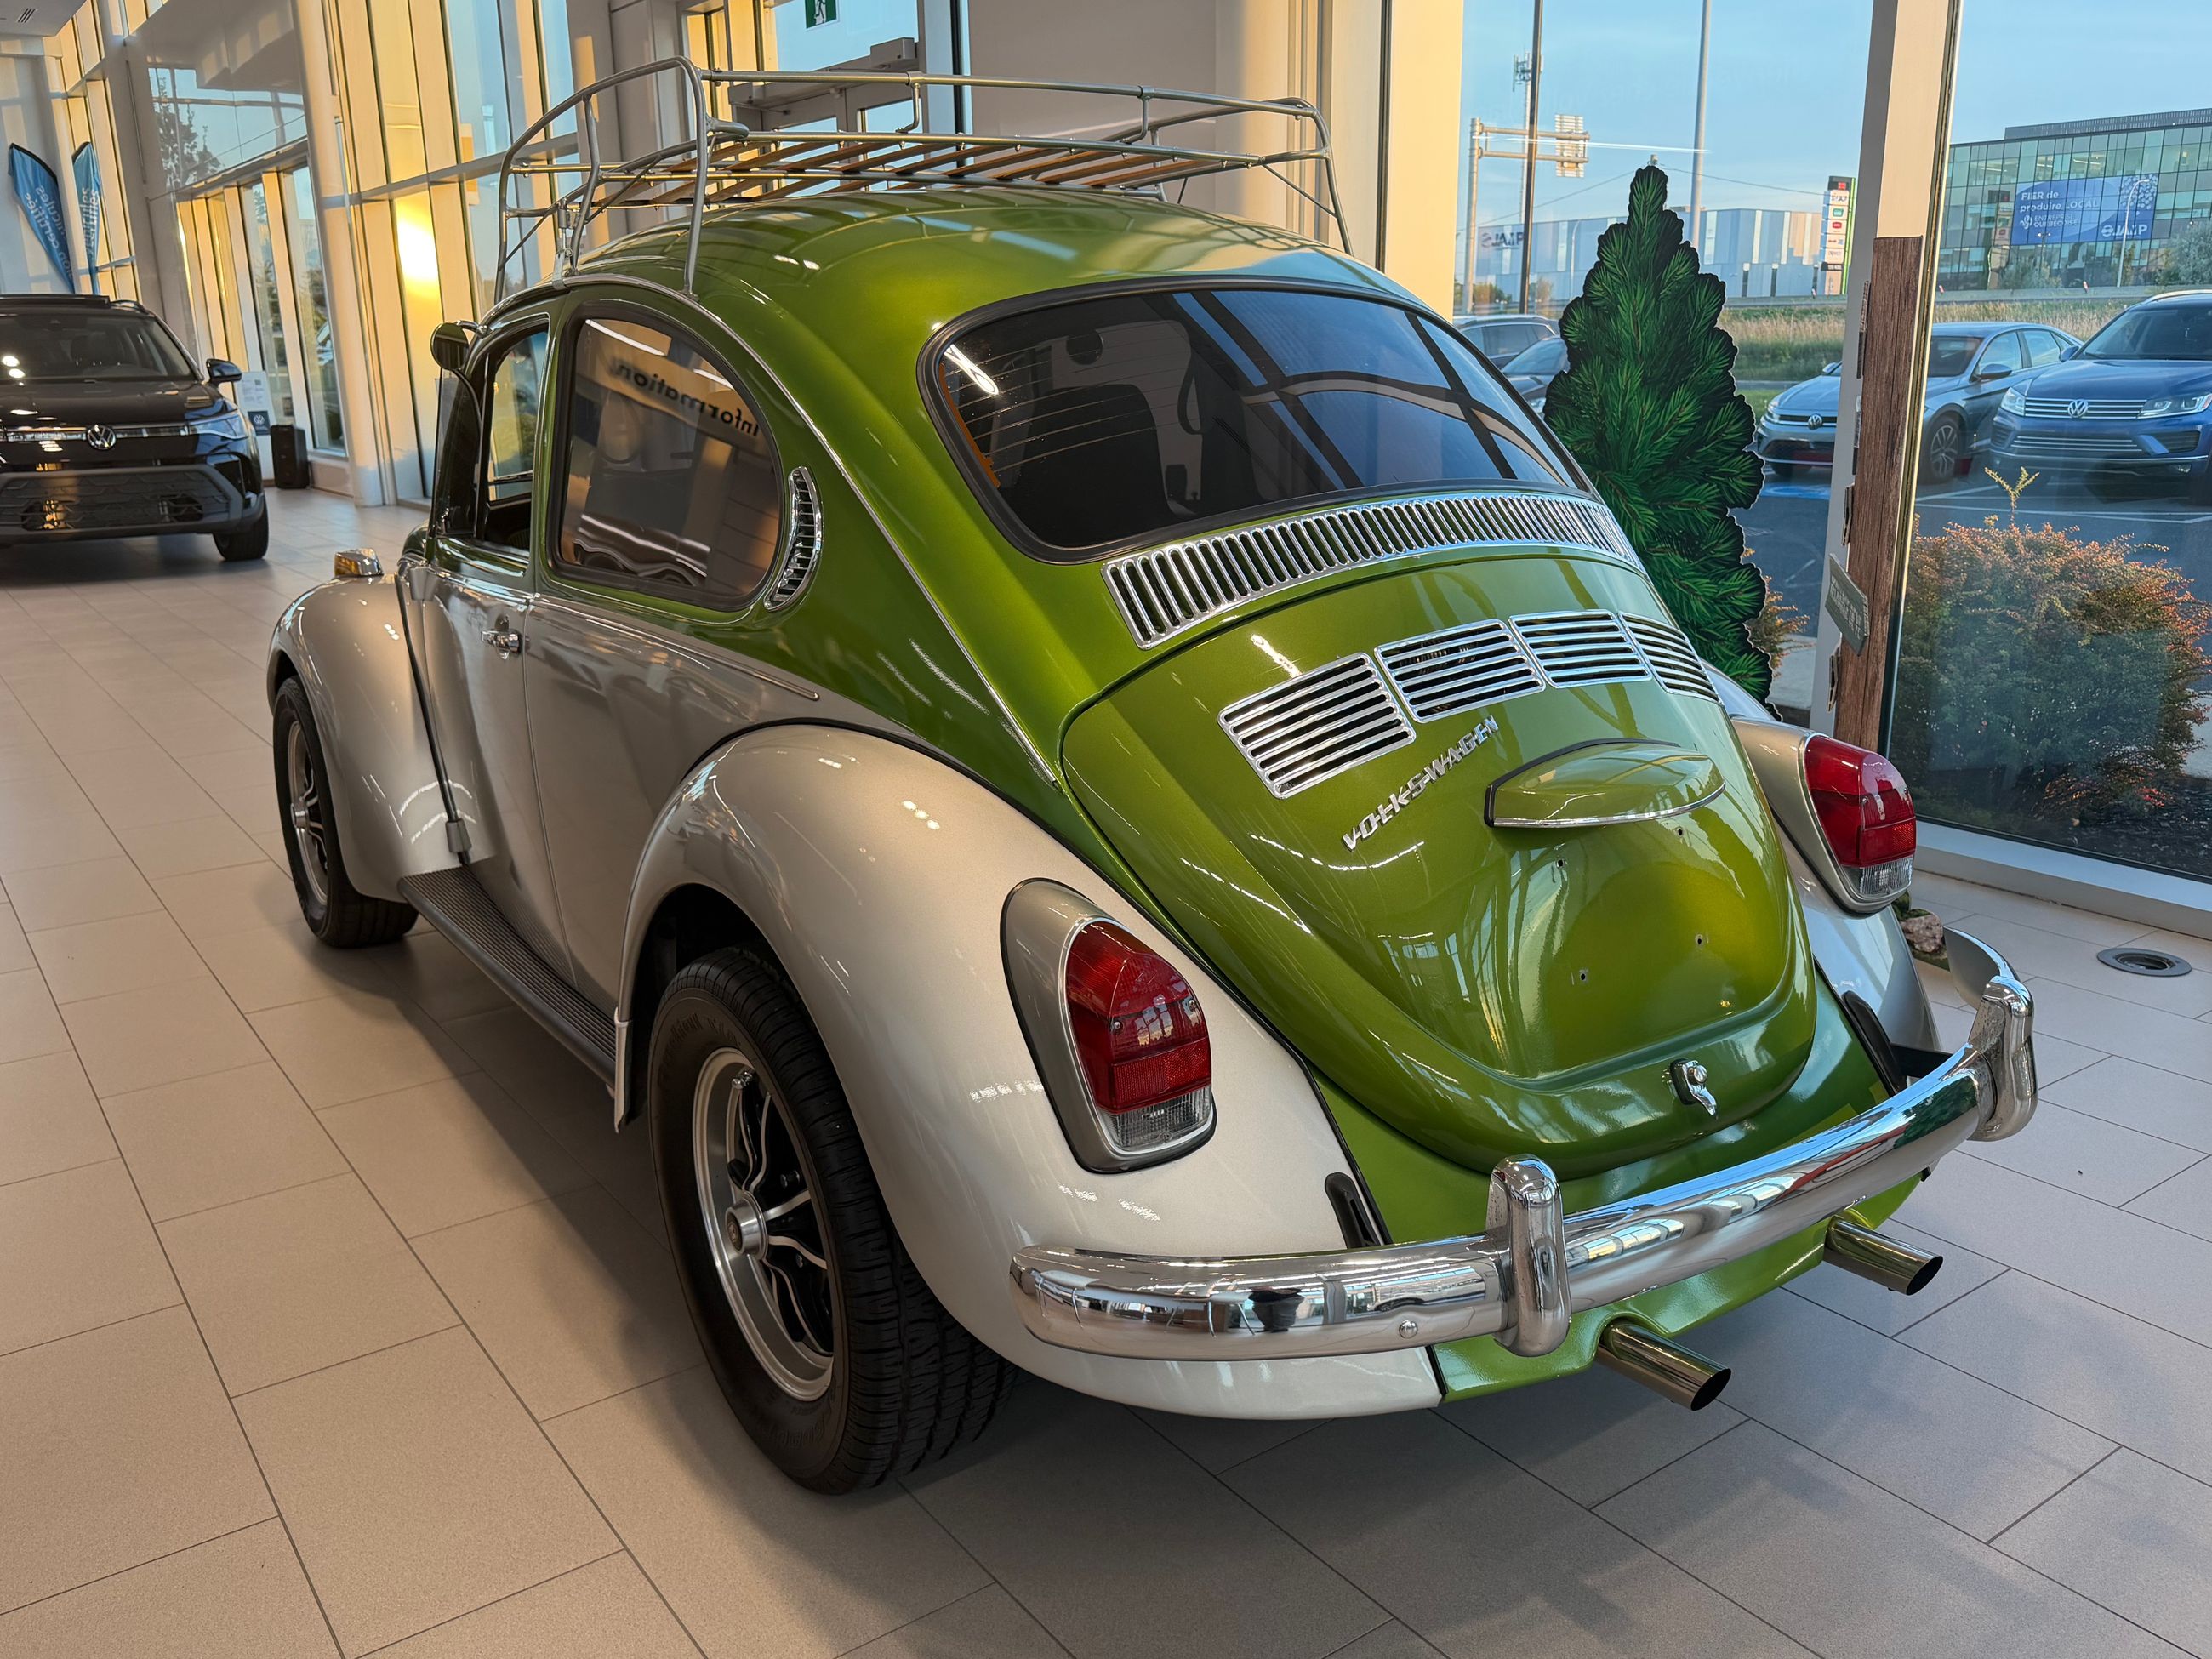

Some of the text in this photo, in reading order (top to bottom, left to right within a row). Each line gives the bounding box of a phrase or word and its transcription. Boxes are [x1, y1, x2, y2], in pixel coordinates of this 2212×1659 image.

[2021, 191, 2059, 201] FIER de
[2020, 199, 2099, 213] produire LOCAL
[1342, 715, 1499, 852] VOLKSWAGEN
